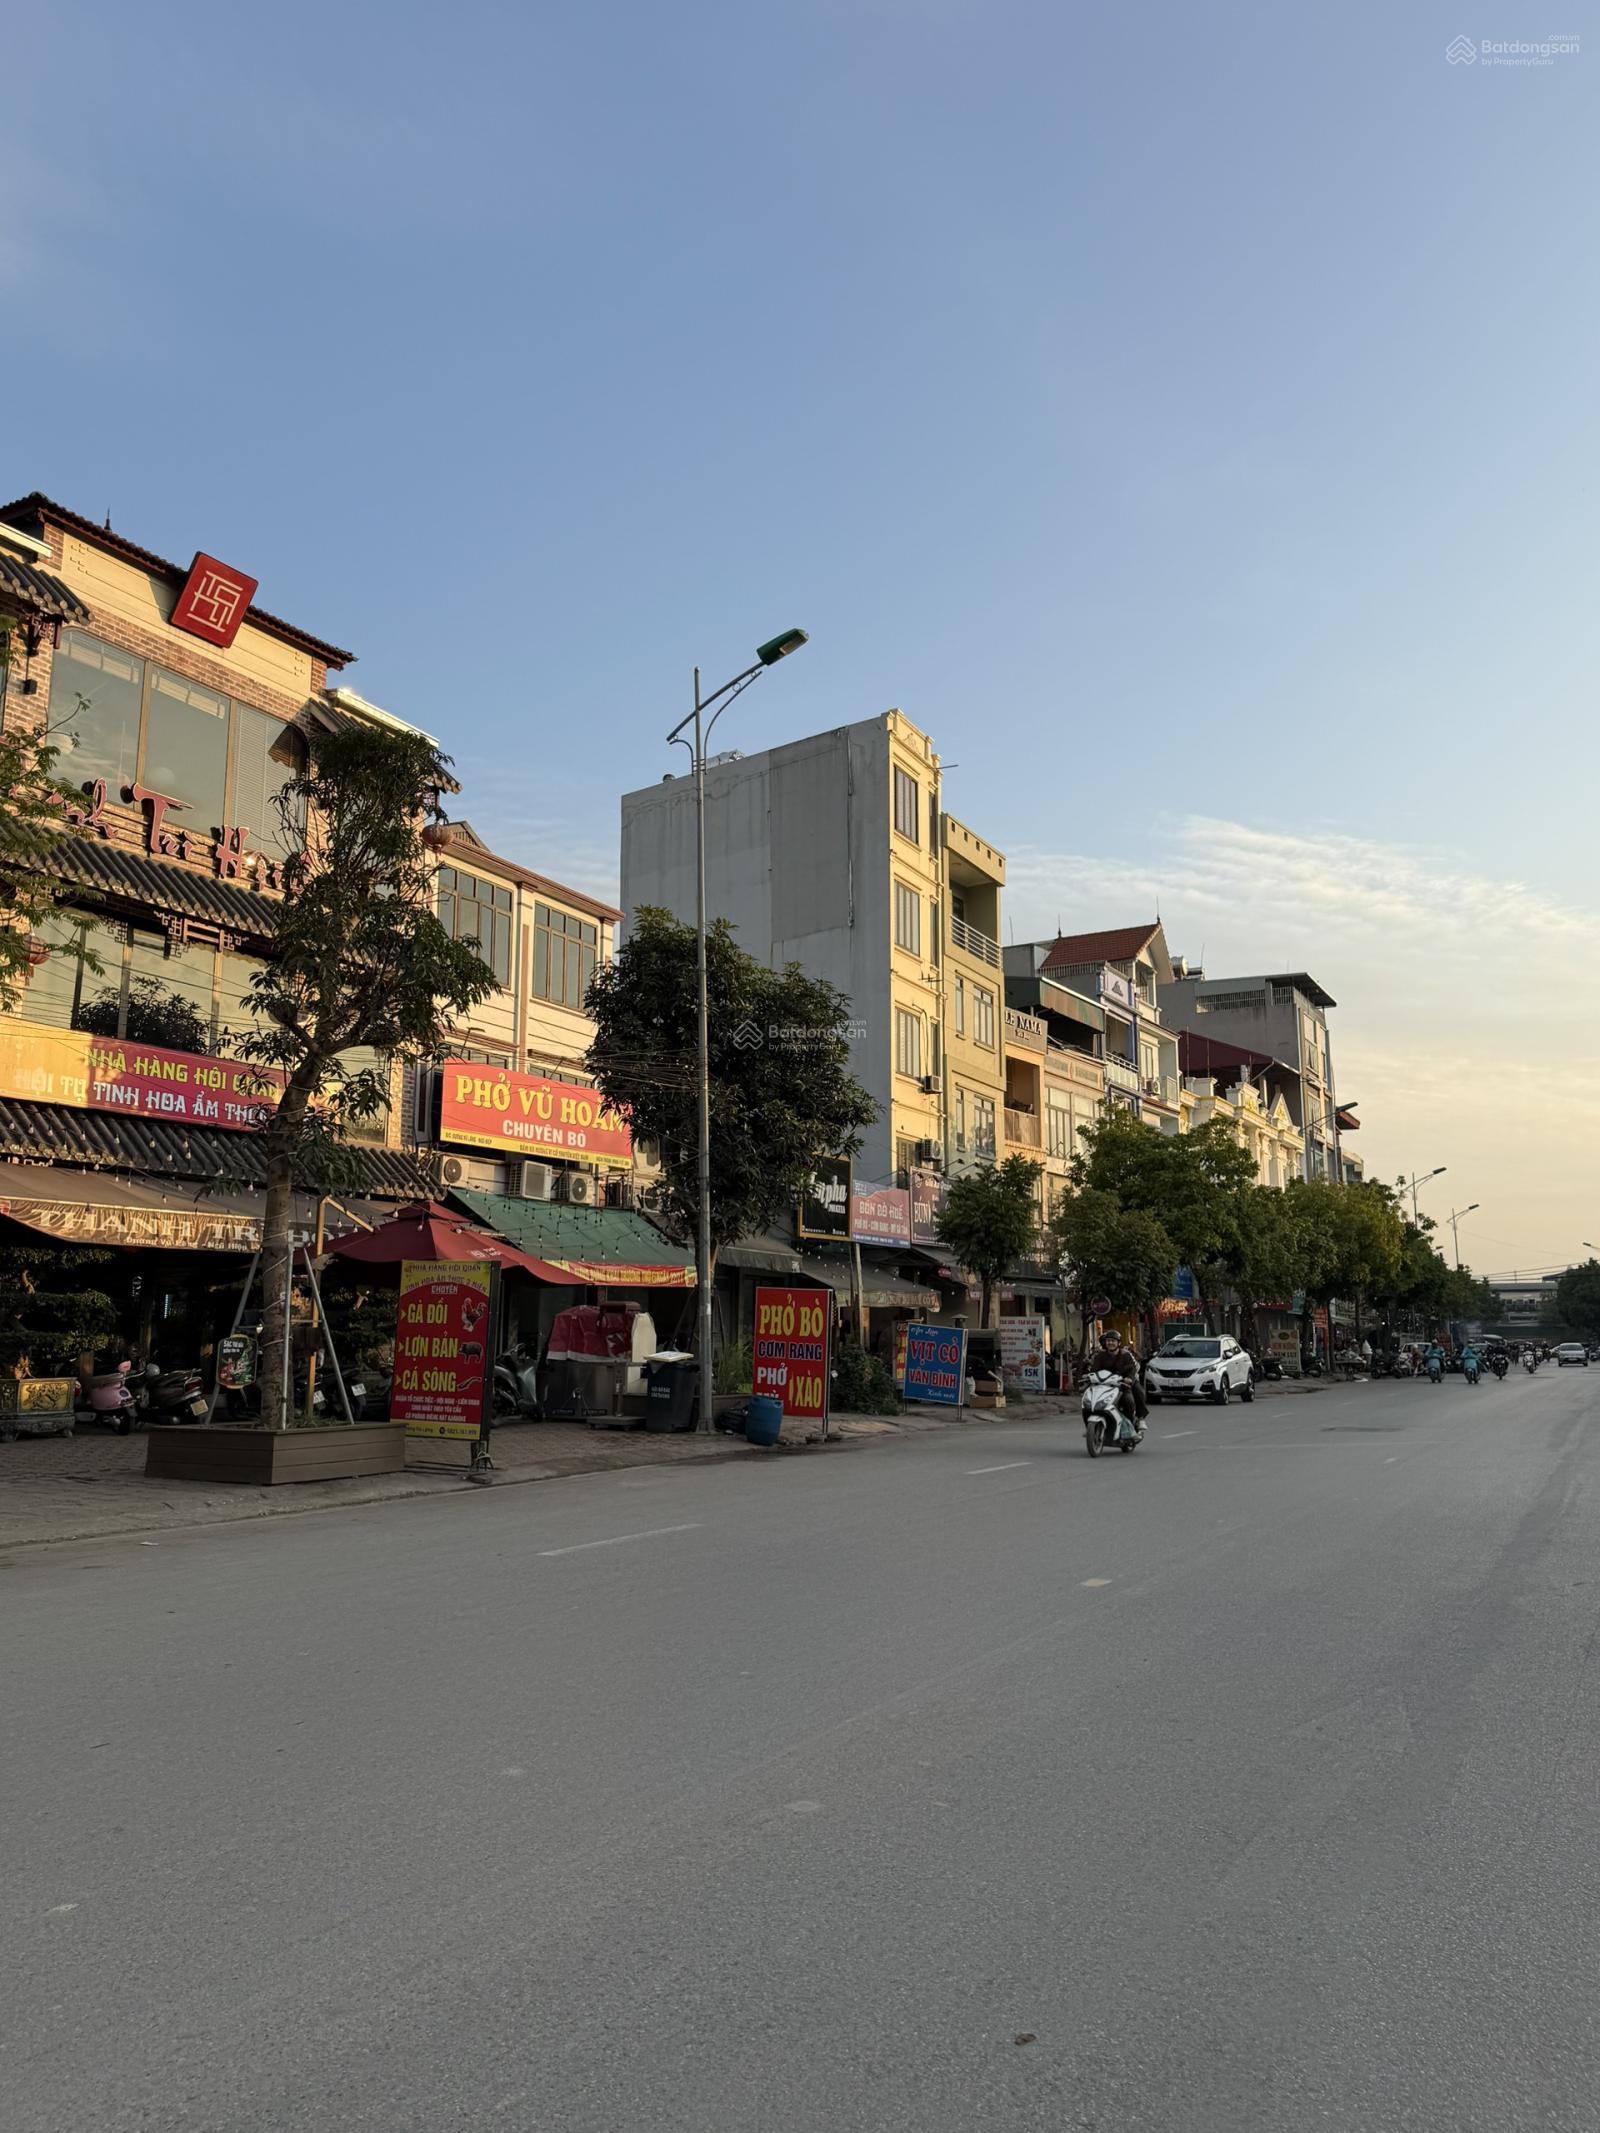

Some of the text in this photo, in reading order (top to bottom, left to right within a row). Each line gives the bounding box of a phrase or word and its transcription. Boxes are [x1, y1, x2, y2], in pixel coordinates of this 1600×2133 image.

[84, 1046, 127, 1074] NHÀ
[133, 1055, 189, 1083] HÀNG
[193, 1066, 227, 1092] HỘI
[60, 1075, 87, 1103] TỤ
[93, 1081, 140, 1107] TINH
[146, 1090, 186, 1114] HOA
[192, 1090, 219, 1118] ẨM
[456, 1073, 511, 1112] PHỞ
[518, 1085, 553, 1120] VŨ
[502, 1119, 563, 1145] CHUYÊN
[567, 1129, 586, 1148] BÒ
[31, 1208, 193, 1238] THANH
[206, 1222, 266, 1243] TR
[408, 1297, 448, 1325] GÀ ĐỒI
[759, 1293, 824, 1337] PHỞ BÒ
[405, 1331, 459, 1361] LỢN BẢN
[758, 1340, 823, 1361] CƠM RANG
[910, 1336, 960, 1366] VỊT CỎ
[402, 1366, 457, 1392] CÁ SÔNG
[757, 1362, 822, 1408] PHỞ XÀO
[909, 1367, 957, 1388] VÂN ĐÌNH
